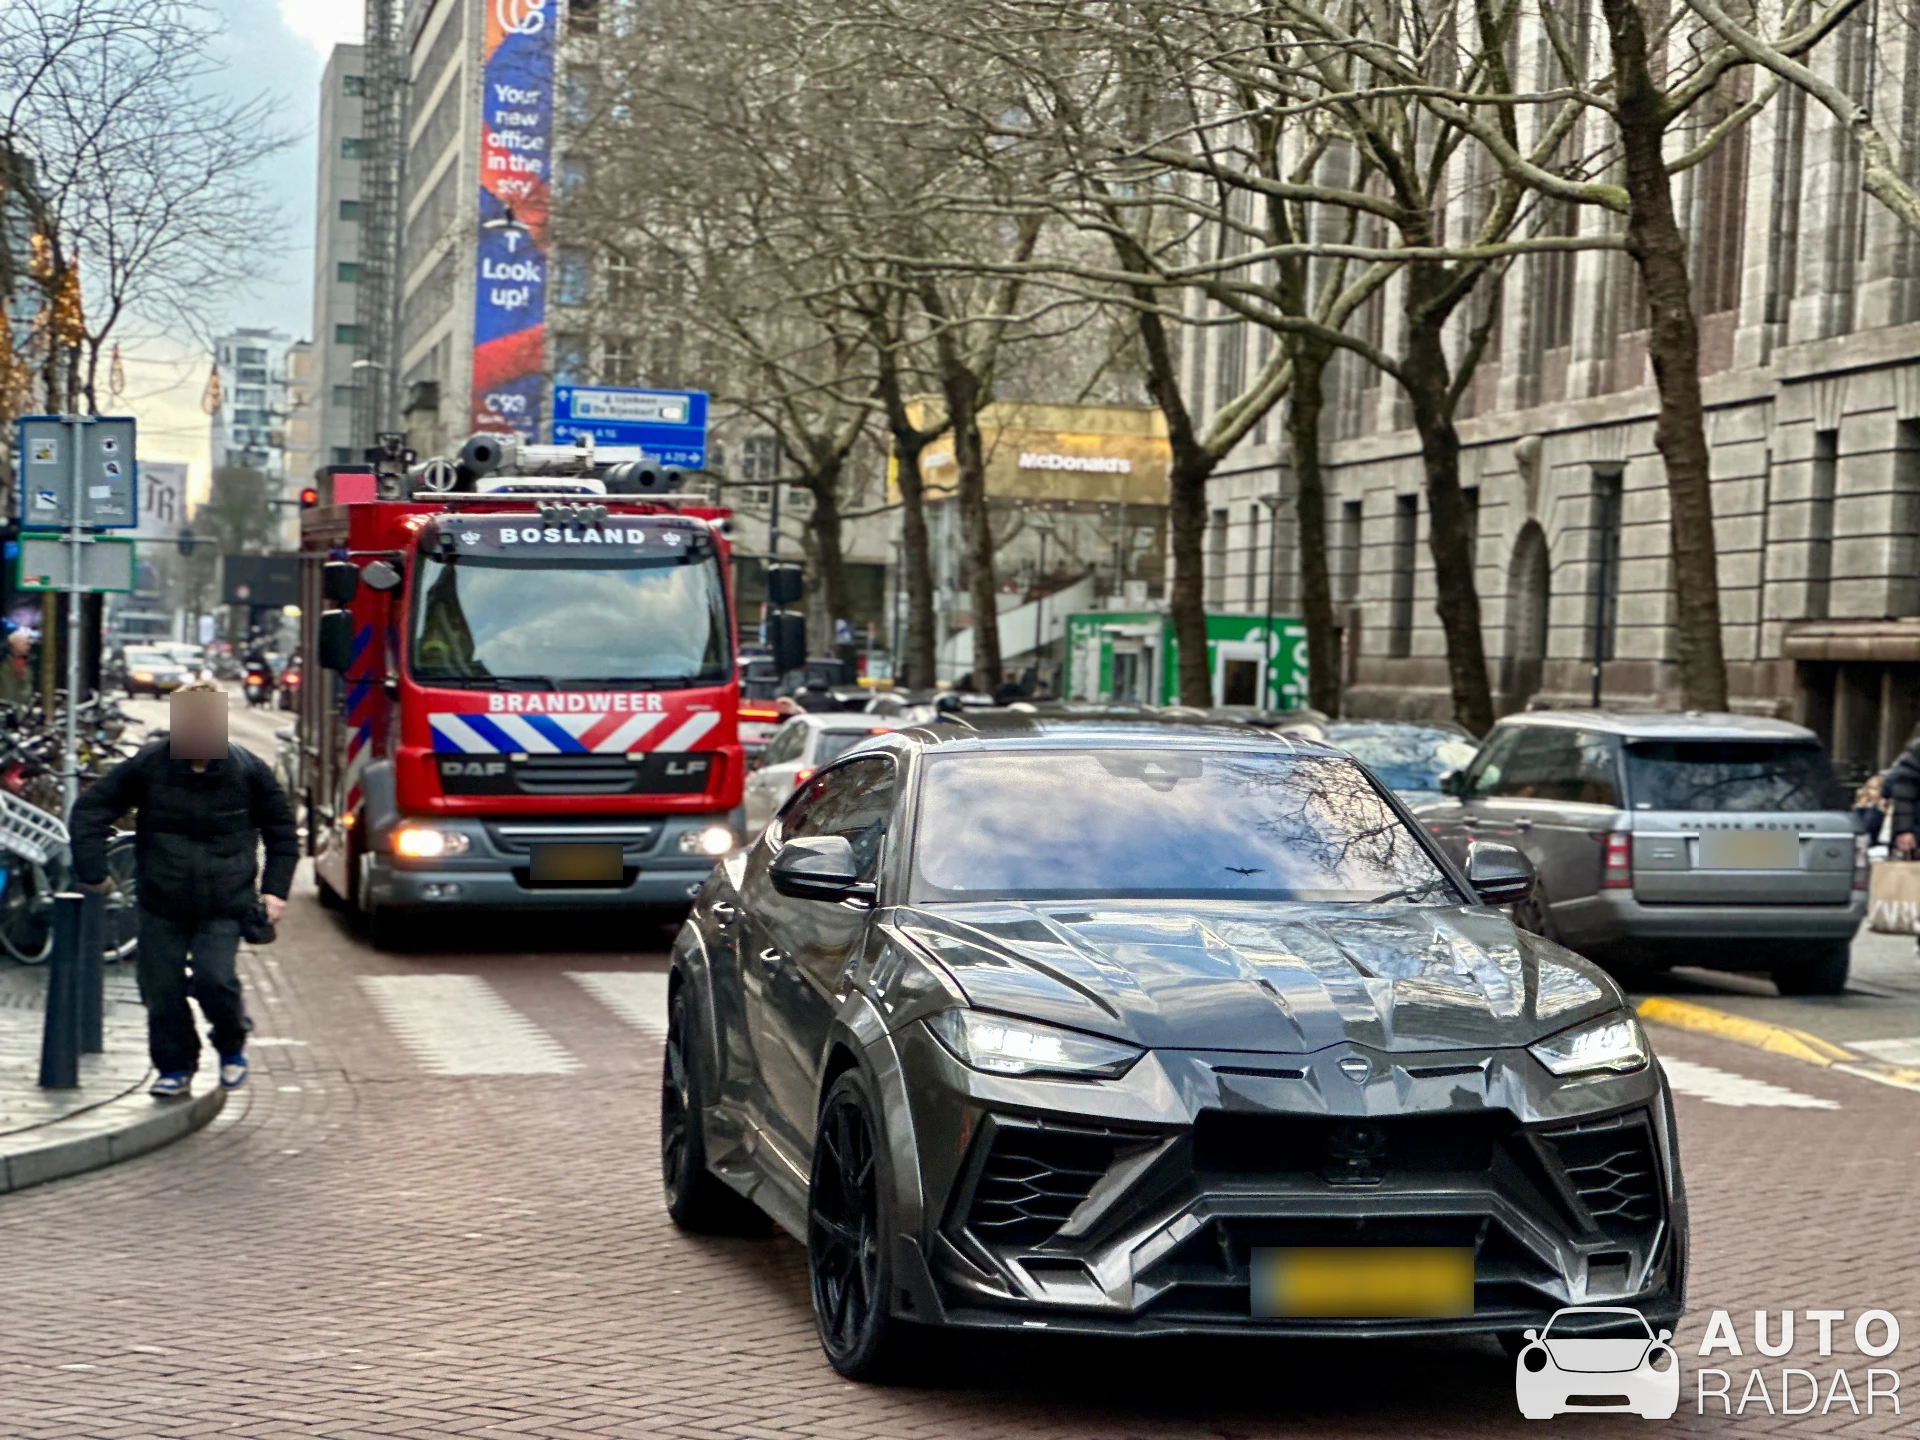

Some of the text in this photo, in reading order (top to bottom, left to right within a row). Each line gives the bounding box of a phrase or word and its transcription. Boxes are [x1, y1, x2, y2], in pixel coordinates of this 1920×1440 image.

[494, 84, 542, 105] Your
[495, 110, 539, 127] new
[487, 130, 545, 151] office
[487, 150, 543, 174] in the
[496, 178, 533, 199] sky
[482, 257, 541, 283] Look
[490, 286, 530, 311] up!
[1018, 452, 1131, 474] McDonald's
[499, 527, 645, 544] BOSLAND
[488, 693, 663, 712] BRANDWEER
[441, 760, 708, 776] DAF LF
